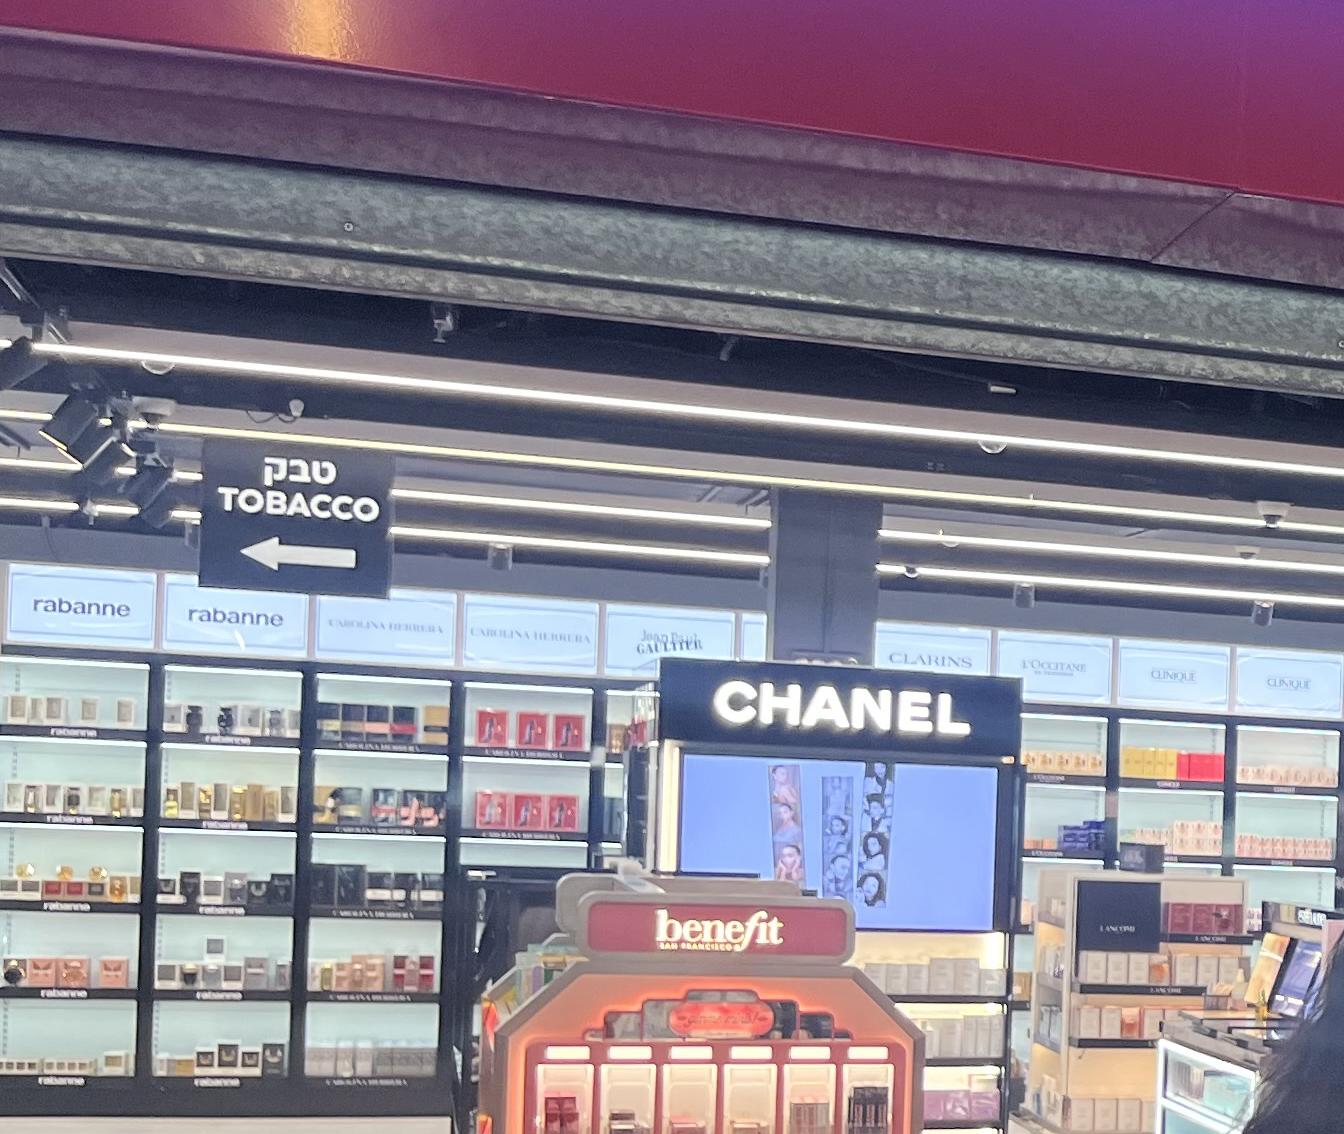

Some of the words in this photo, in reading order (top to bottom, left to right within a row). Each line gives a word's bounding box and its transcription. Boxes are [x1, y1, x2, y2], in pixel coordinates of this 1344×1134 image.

[263, 456, 337, 487] טבק
[217, 486, 380, 522] TOBACCO
[32, 596, 131, 617] rabanne
[187, 606, 284, 627] rabanne
[328, 618, 386, 630] CAROLINA
[388, 622, 444, 634] HERRERA
[470, 626, 531, 639] CAROLINA
[533, 630, 592, 644] HERRERA
[888, 652, 973, 668] CLARINS
[1022, 659, 1087, 673] L'OCCITANE
[1150, 669, 1197, 682] CLINIQUE
[1267, 678, 1312, 690] CLINIQUE
[712, 678, 972, 738] CHANEL
[655, 908, 784, 950] benefit
